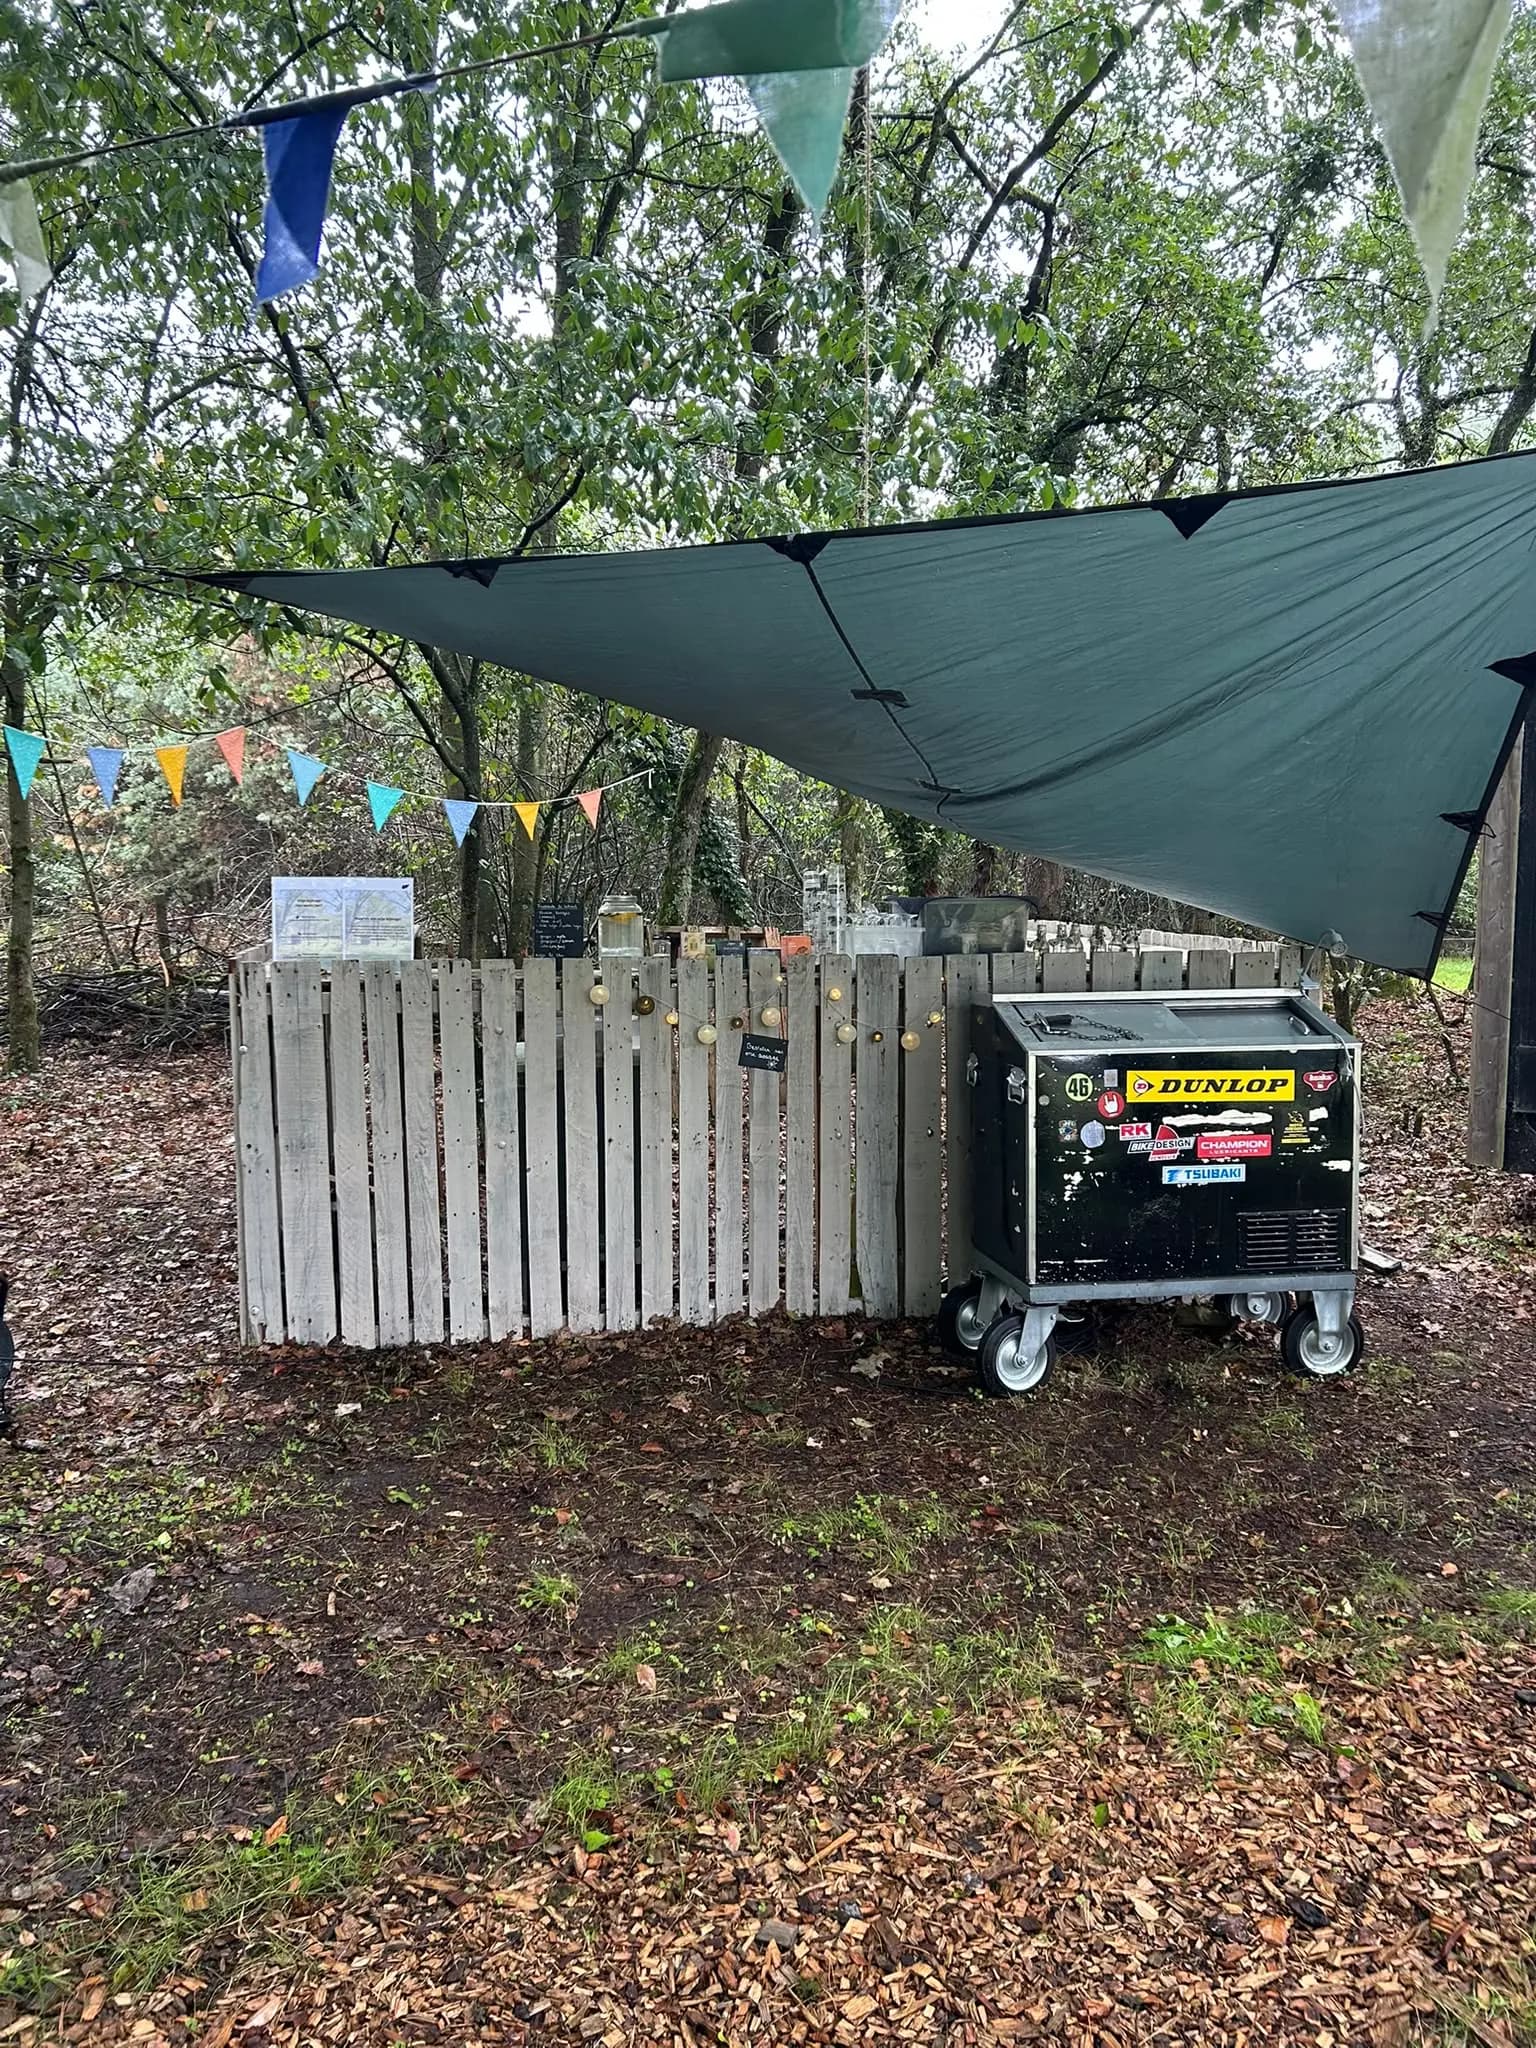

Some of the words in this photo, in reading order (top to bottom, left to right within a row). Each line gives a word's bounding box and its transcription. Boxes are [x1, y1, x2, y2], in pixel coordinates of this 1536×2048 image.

[1068, 1078, 1089, 1097] 46
[1158, 1078, 1289, 1093] DUNLOP
[1121, 1124, 1150, 1137] RK
[1130, 1142, 1154, 1152] BIKE
[1155, 1140, 1191, 1149] DESIGN
[1200, 1140, 1267, 1150] CHAMPION
[1184, 1168, 1241, 1180] TSUBAKI
